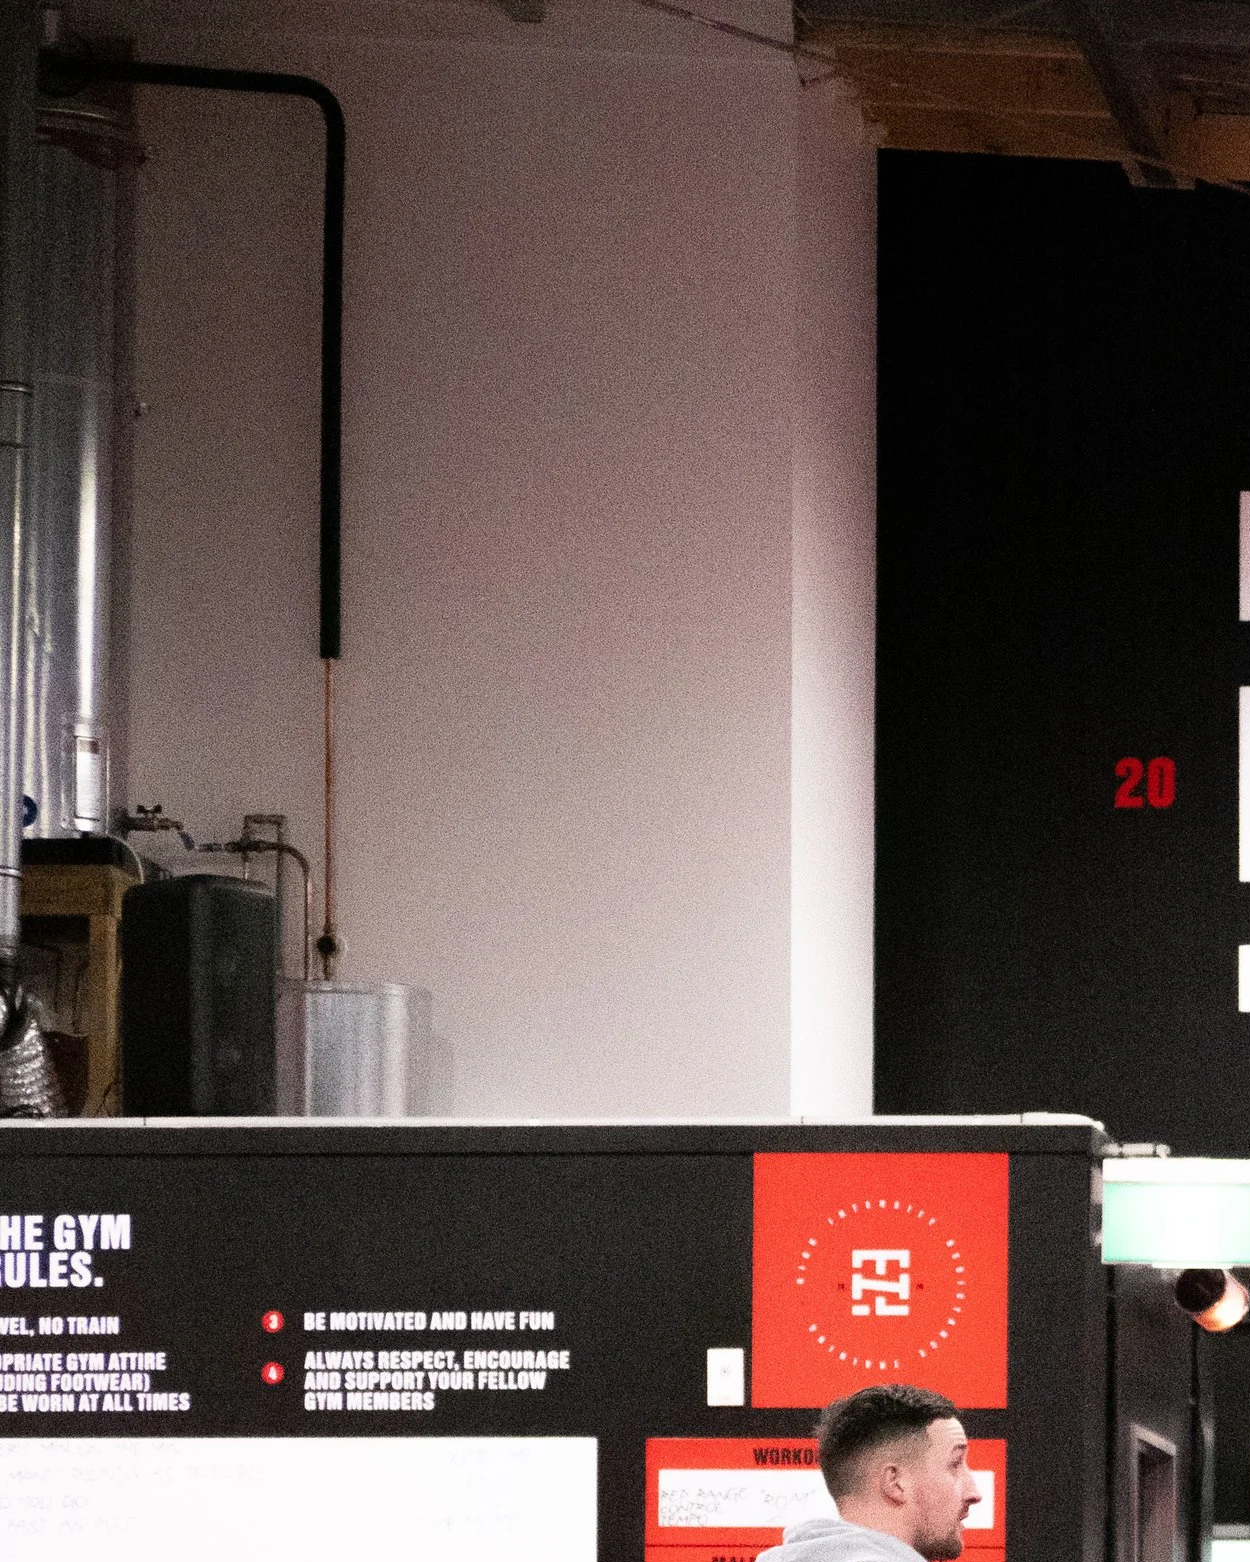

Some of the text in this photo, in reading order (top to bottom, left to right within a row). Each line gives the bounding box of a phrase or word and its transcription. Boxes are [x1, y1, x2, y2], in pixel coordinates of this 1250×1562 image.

[1114, 757, 1176, 810] 20
[54, 1213, 131, 1250] GYM
[0, 1251, 104, 1289] ULES.
[38, 1317, 65, 1336] NO
[67, 1316, 120, 1336] TRAIN
[269, 1311, 555, 1331] 3 BE MOTIVATED AND HAVE FUN
[0, 1352, 167, 1372] PRIATE GYM ATTIRE
[268, 1350, 570, 1381] 4 ALWAYS RESPECT, ENCOURAGE
[0, 1373, 151, 1393] DING FOOTWEAR)
[303, 1371, 547, 1390] AND SUPPORT YOUR FELLOW
[21, 1393, 75, 1412] WORN
[77, 1393, 100, 1412] AT
[102, 1393, 134, 1412] ALL
[136, 1392, 191, 1411] TIMES
[303, 1391, 436, 1411] GYM MEMBERS
[753, 1448, 819, 1465] WORKO
